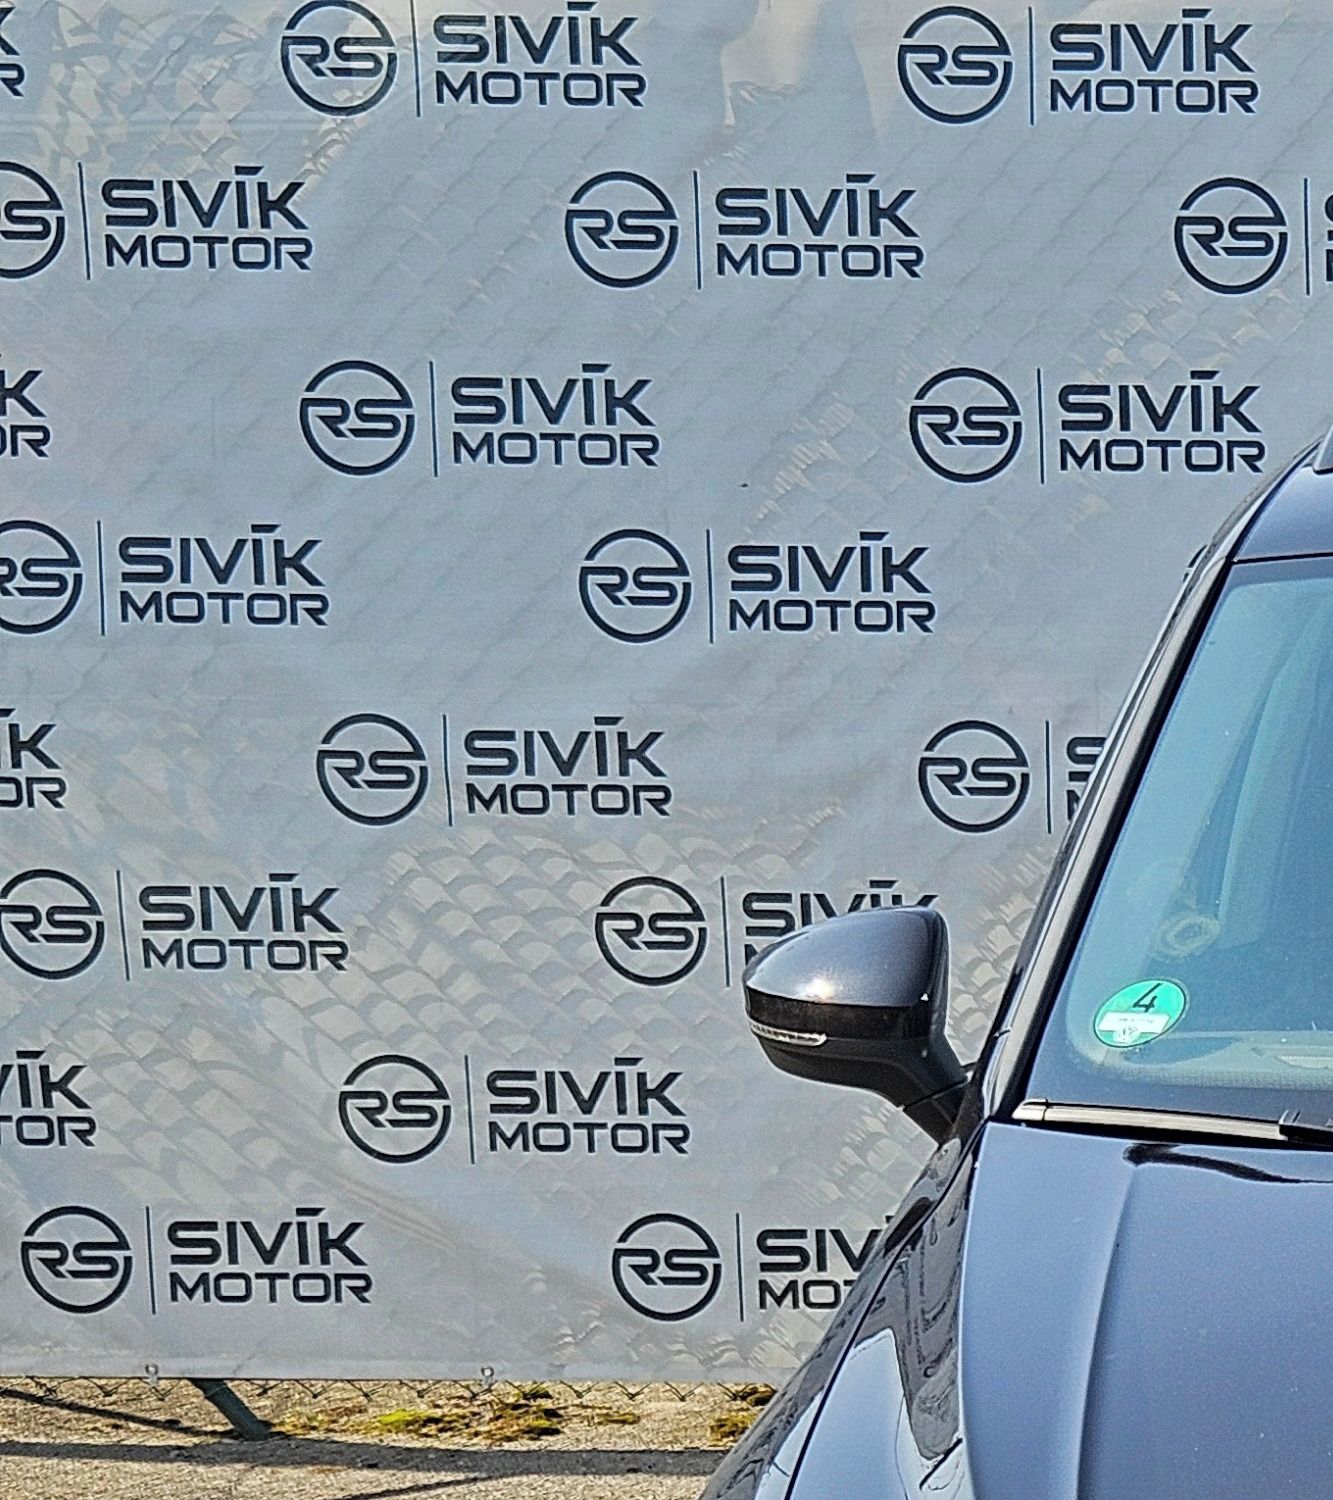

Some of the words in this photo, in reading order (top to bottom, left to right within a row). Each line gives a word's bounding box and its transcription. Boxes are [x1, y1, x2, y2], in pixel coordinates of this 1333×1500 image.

[436, 72, 645, 106] MOTOR
[1051, 79, 1258, 113] MOTOR
[105, 234, 312, 269] MOTOR
[717, 243, 923, 278] MOTOR
[453, 432, 659, 466] MOTOR
[1060, 439, 1265, 472] MOTOR
[120, 591, 328, 625] MOTOR
[730, 600, 935, 632] MOTOR
[466, 783, 671, 815] MOTOR
[142, 938, 348, 970] MOTOR
[1132, 982, 1164, 1013] 4
[489, 1122, 689, 1153] MOTOR
[170, 1272, 372, 1303] MOTOR
